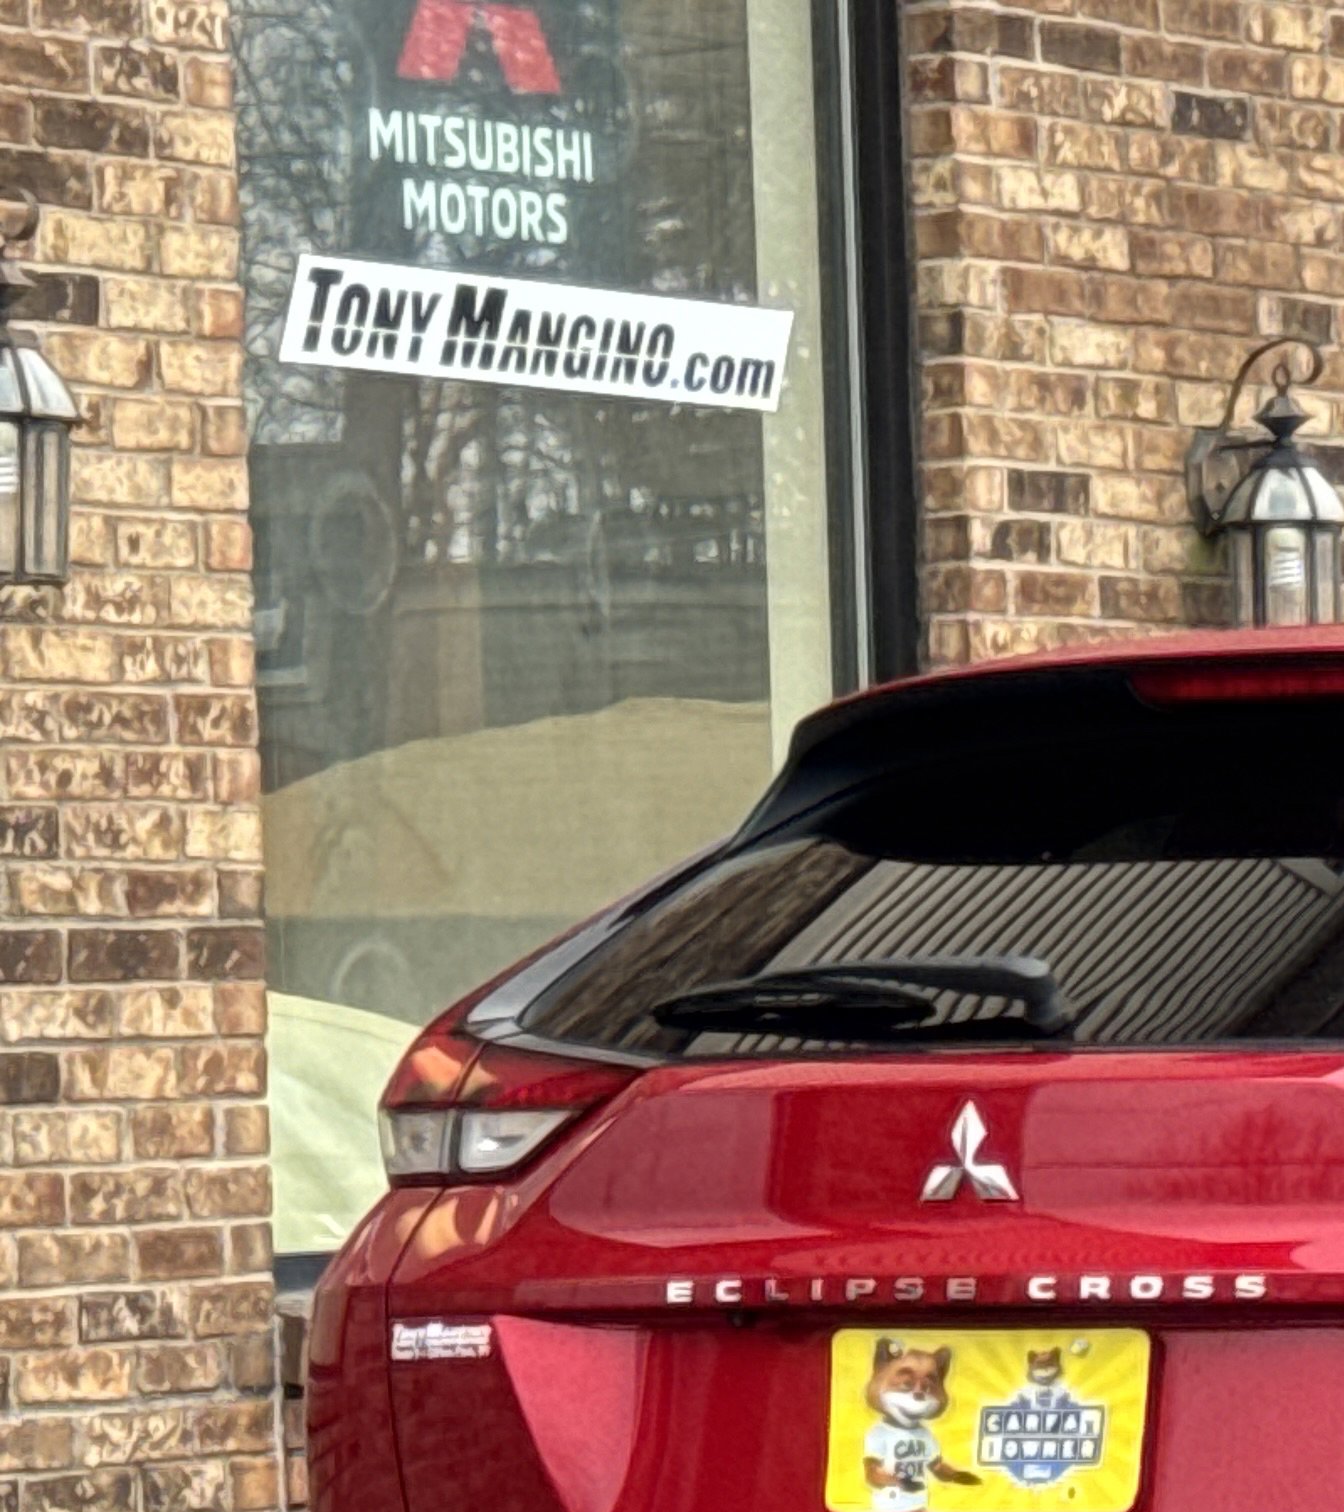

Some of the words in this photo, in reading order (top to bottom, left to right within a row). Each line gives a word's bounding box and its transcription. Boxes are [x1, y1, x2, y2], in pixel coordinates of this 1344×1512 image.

[369, 107, 595, 183] MITSUBISHI
[402, 179, 568, 245] MOTORS
[302, 267, 442, 363] TONY
[665, 1276, 977, 1304] ECLIPSE
[1027, 1274, 1268, 1301] CROSS
